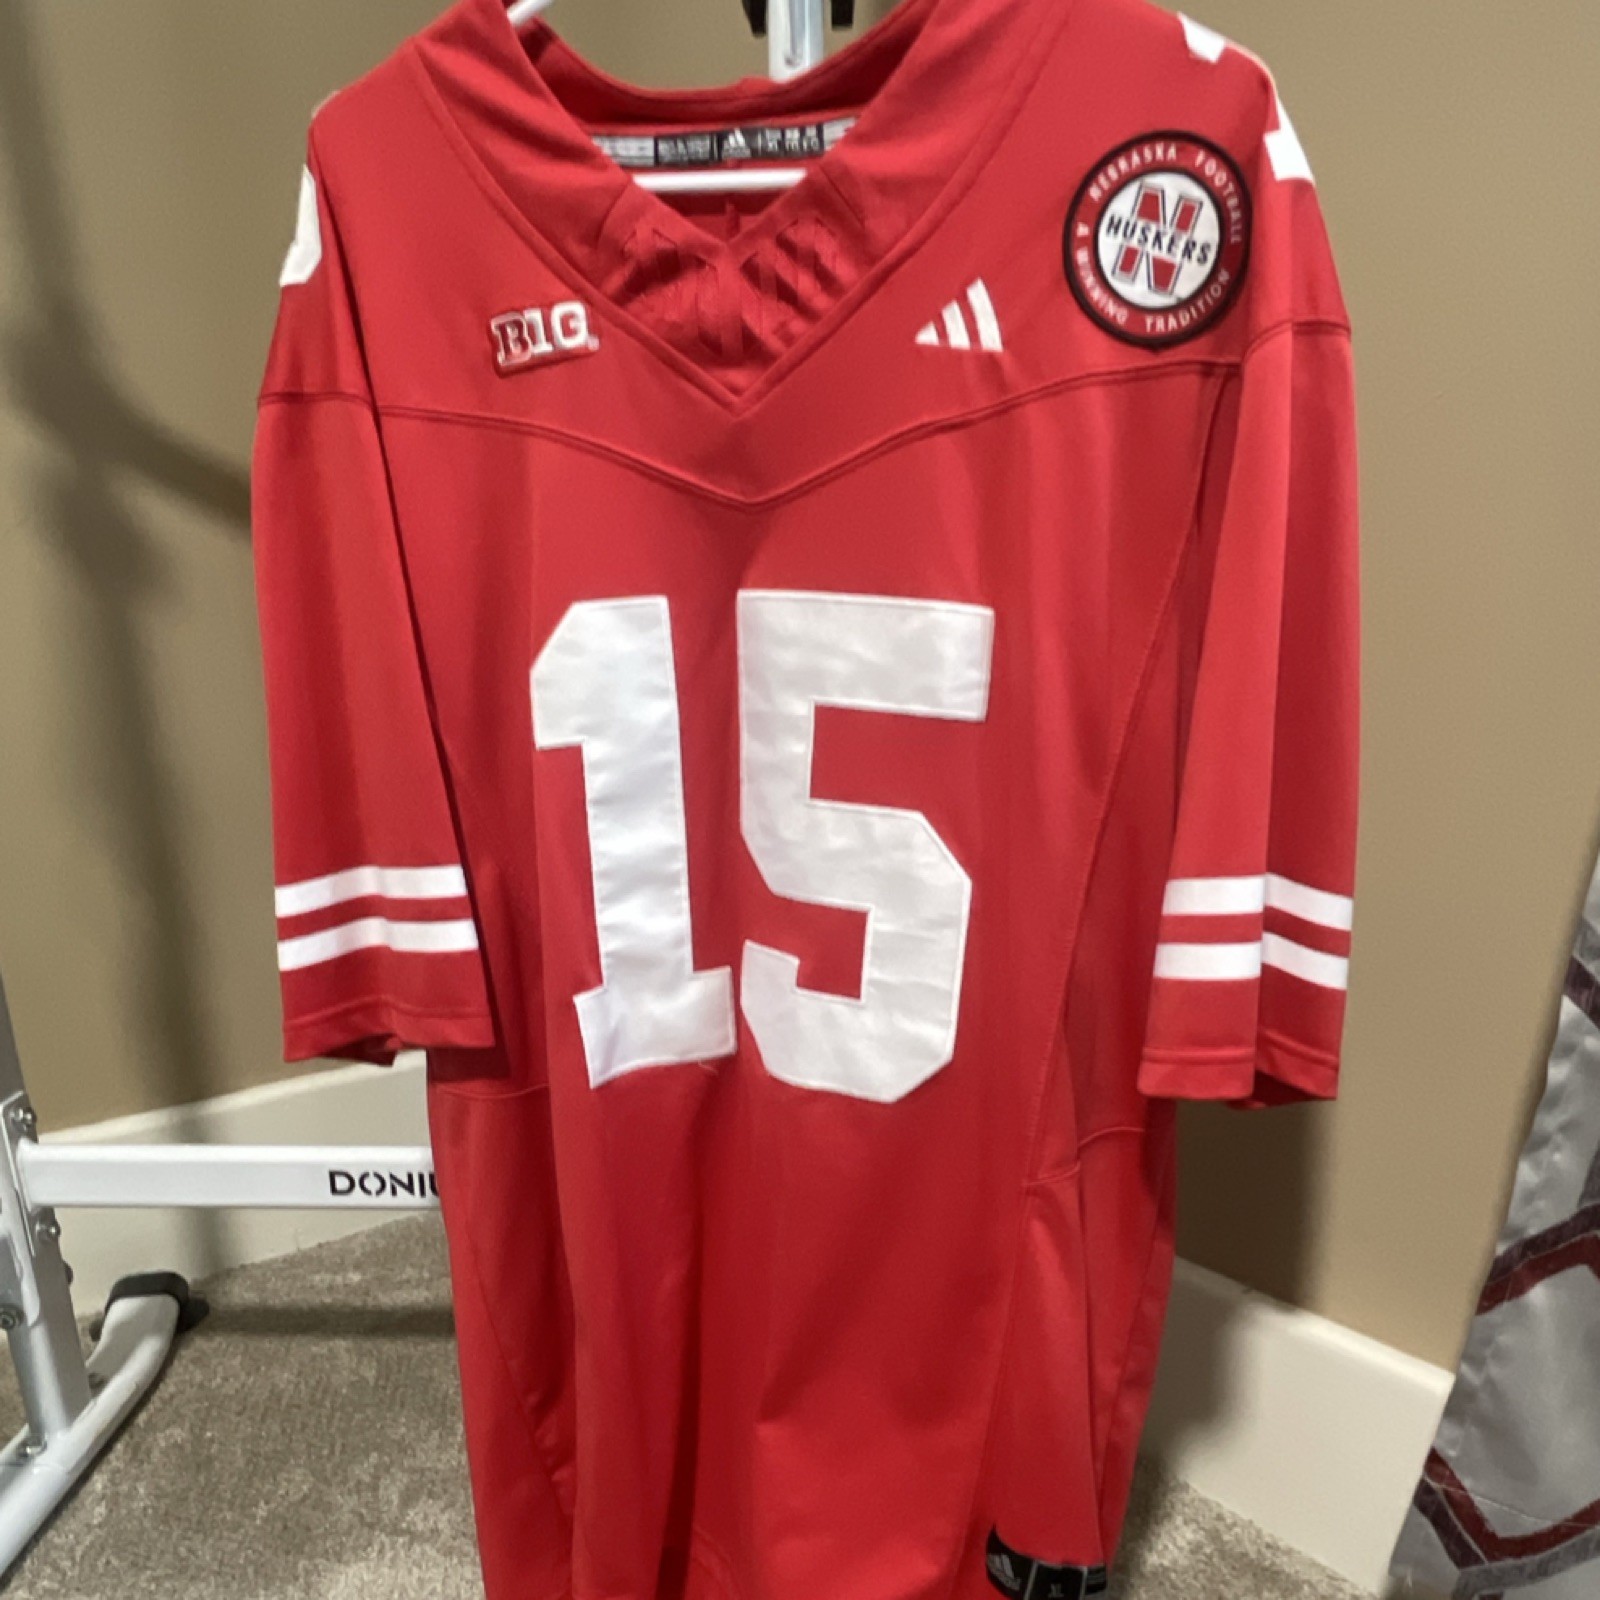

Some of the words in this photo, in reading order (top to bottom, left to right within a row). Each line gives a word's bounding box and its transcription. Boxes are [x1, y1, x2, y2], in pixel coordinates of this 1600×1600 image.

[1089, 143, 1178, 202] NEBRASKA
[1194, 149, 1242, 244] FOOTBALL
[1105, 212, 1212, 266] HUSKERS
[1144, 267, 1230, 334] TRADITION
[530, 588, 995, 1104] 15
